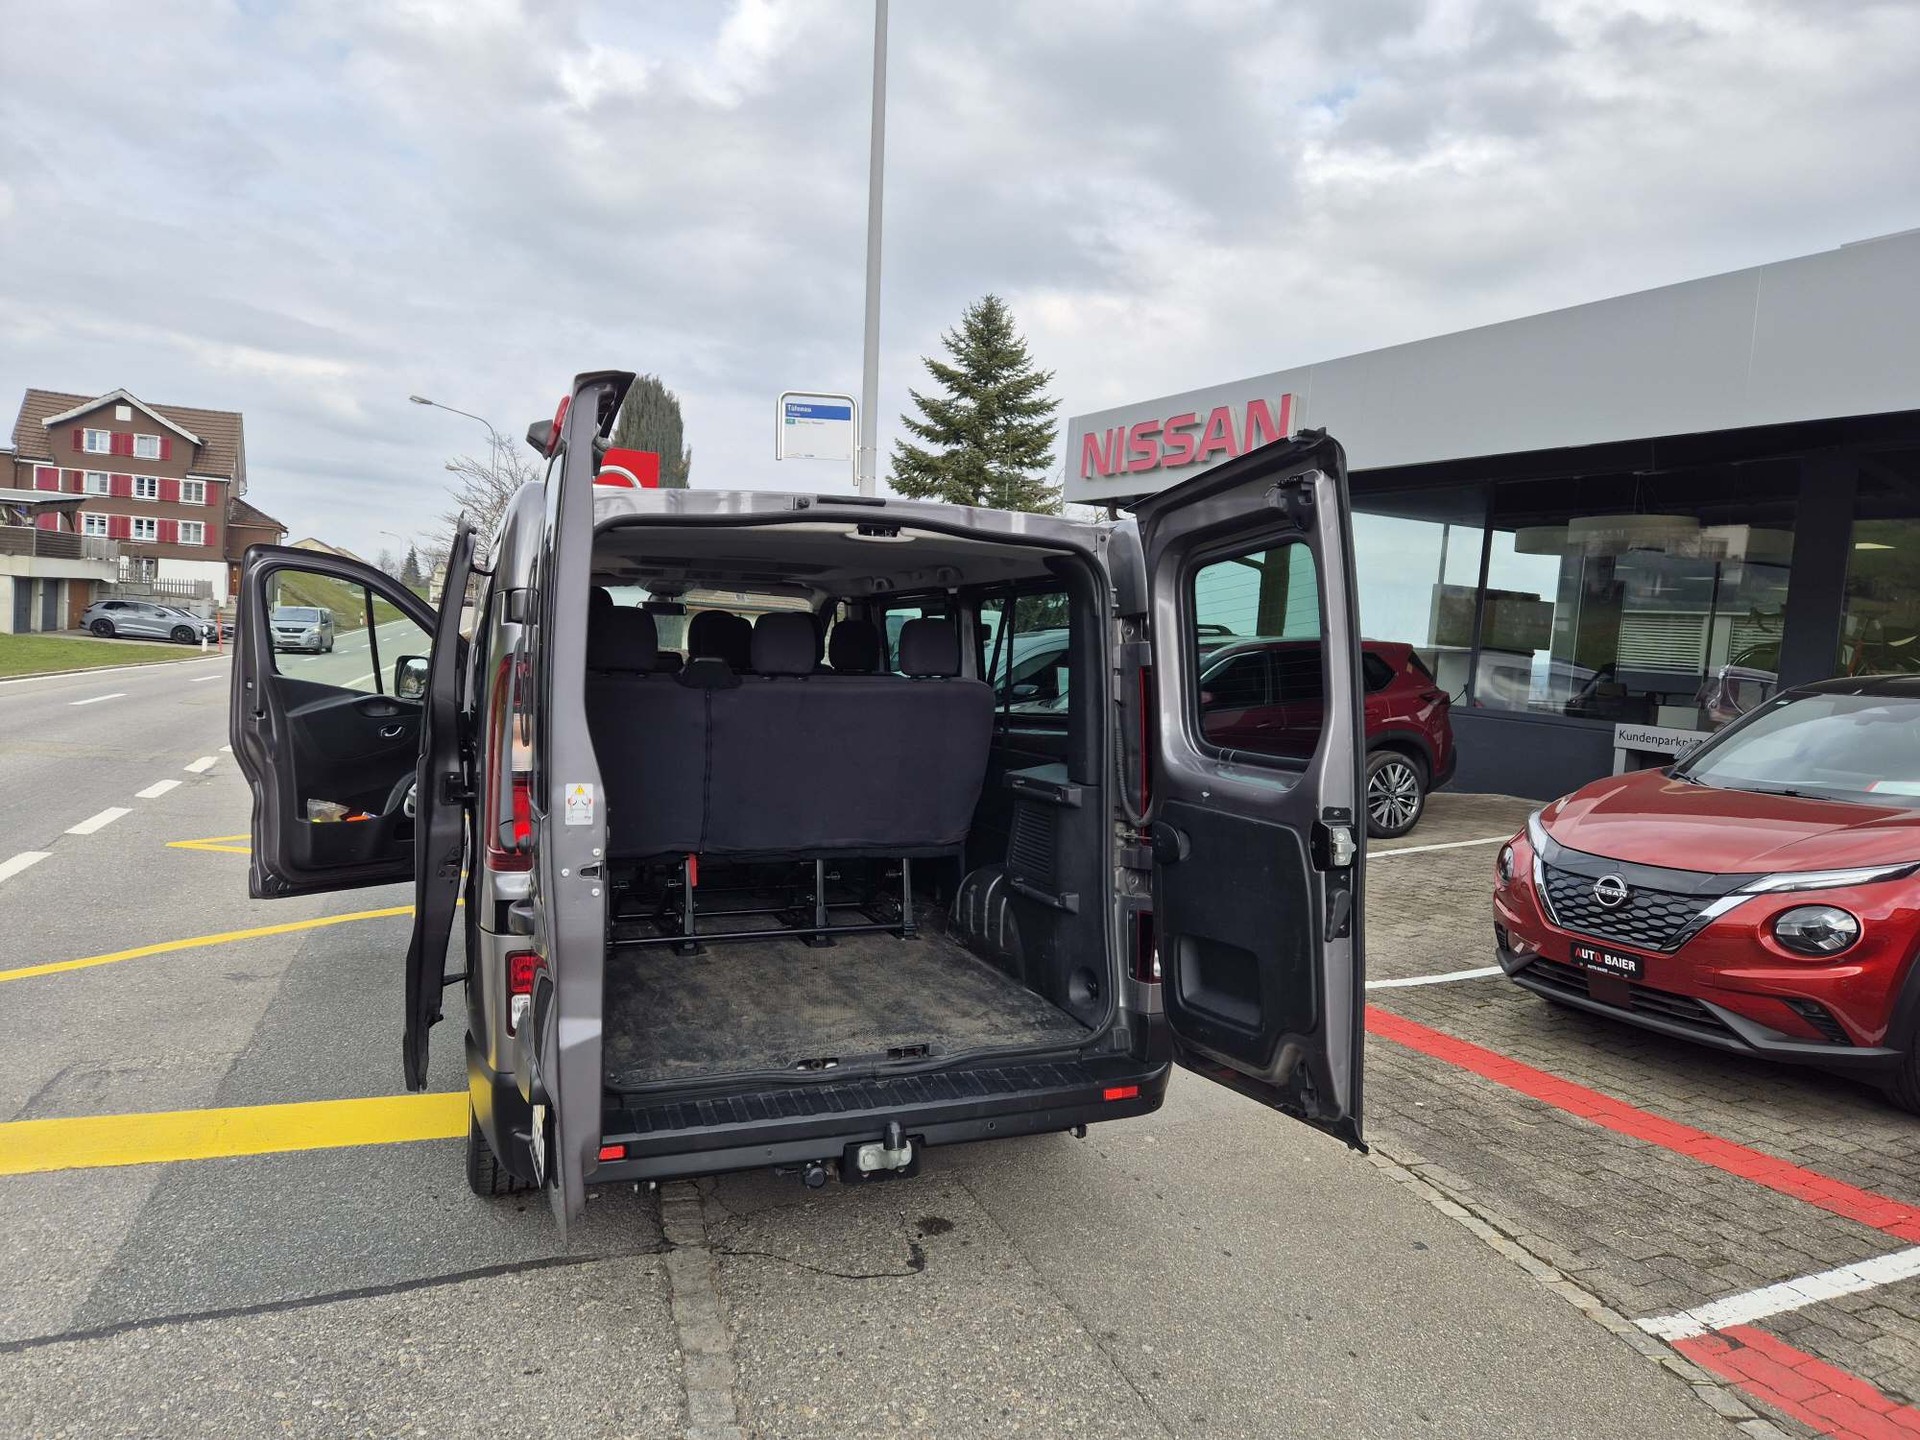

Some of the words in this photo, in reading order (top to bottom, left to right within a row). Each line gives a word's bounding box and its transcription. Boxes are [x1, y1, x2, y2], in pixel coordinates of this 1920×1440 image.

[1080, 393, 1293, 478] NISSAN
[1593, 885, 1627, 898] NISSAN
[1575, 946, 1602, 964] AUTO
[1604, 954, 1636, 971] BAIER
